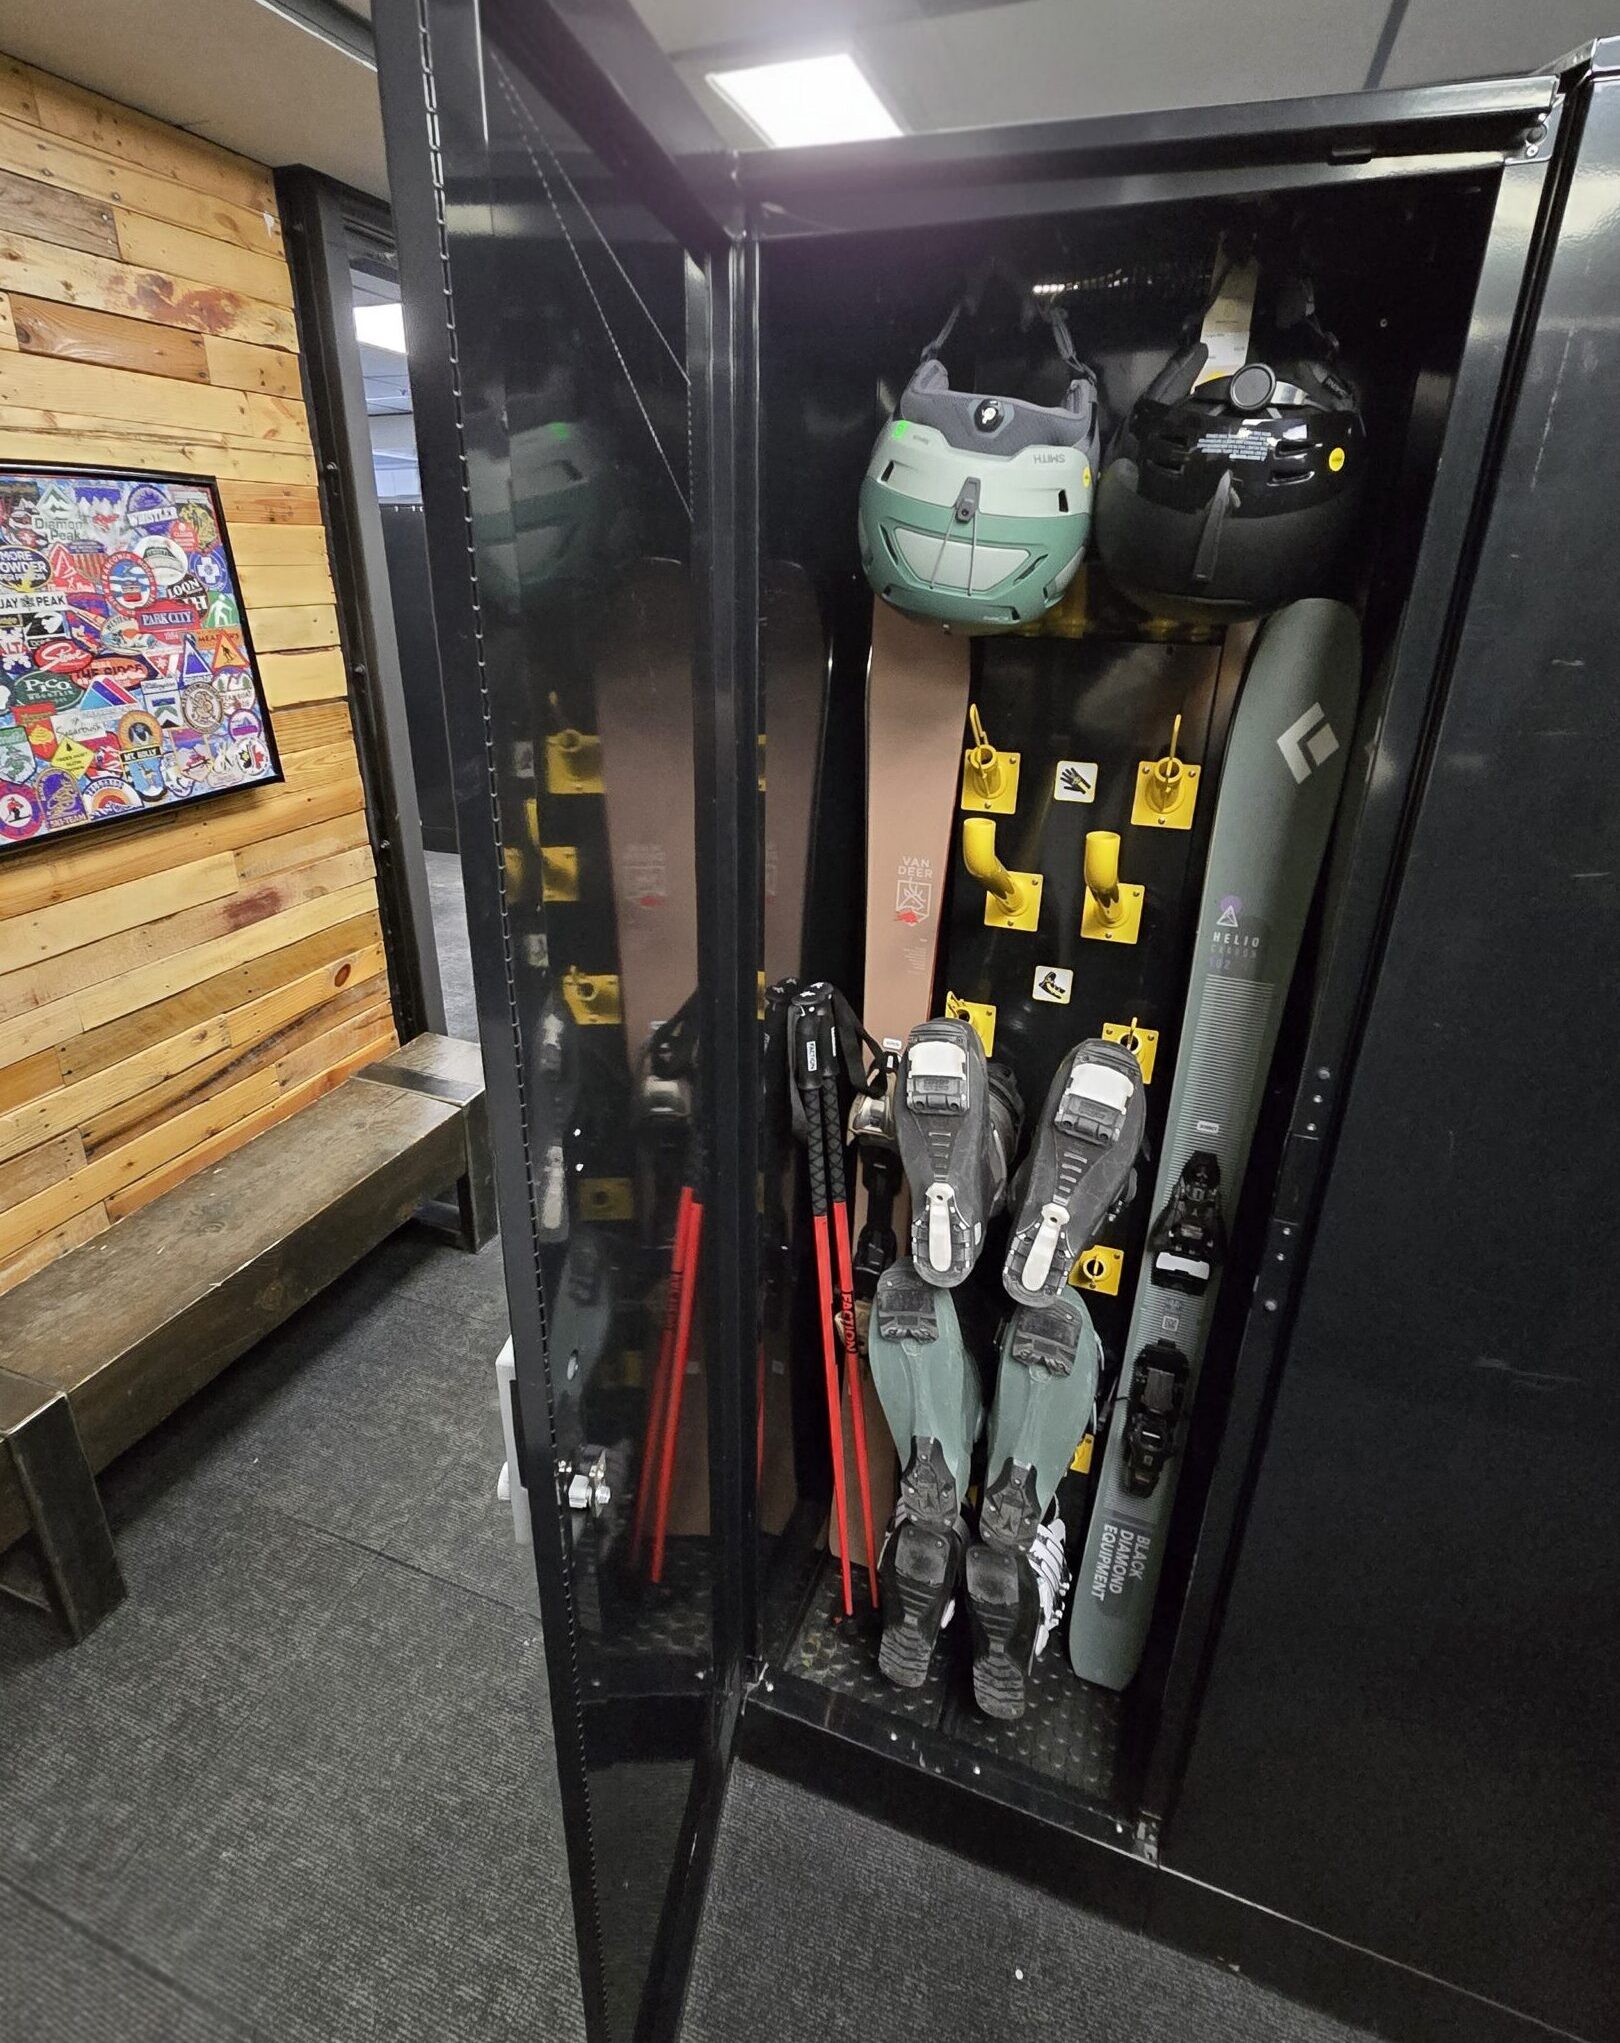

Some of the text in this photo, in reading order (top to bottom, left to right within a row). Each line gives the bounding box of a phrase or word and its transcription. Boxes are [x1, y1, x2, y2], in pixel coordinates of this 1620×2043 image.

[1033, 453, 1066, 465] SMITH
[50, 529, 80, 541] Peak
[0, 562, 48, 574] OWDER
[167, 578, 201, 599] LOON
[0, 595, 66, 609] JAY PEAK
[142, 611, 193, 626] PARK CITY
[903, 856, 930, 868] VAN
[898, 865, 934, 879] DEER
[1213, 931, 1260, 948] HELIO
[842, 1293, 856, 1353] FACTION
[1091, 1523, 1118, 1602] EQUIPMENT
[1109, 1528, 1135, 1595] DIAMOND
[1128, 1534, 1151, 1581] BLACK
